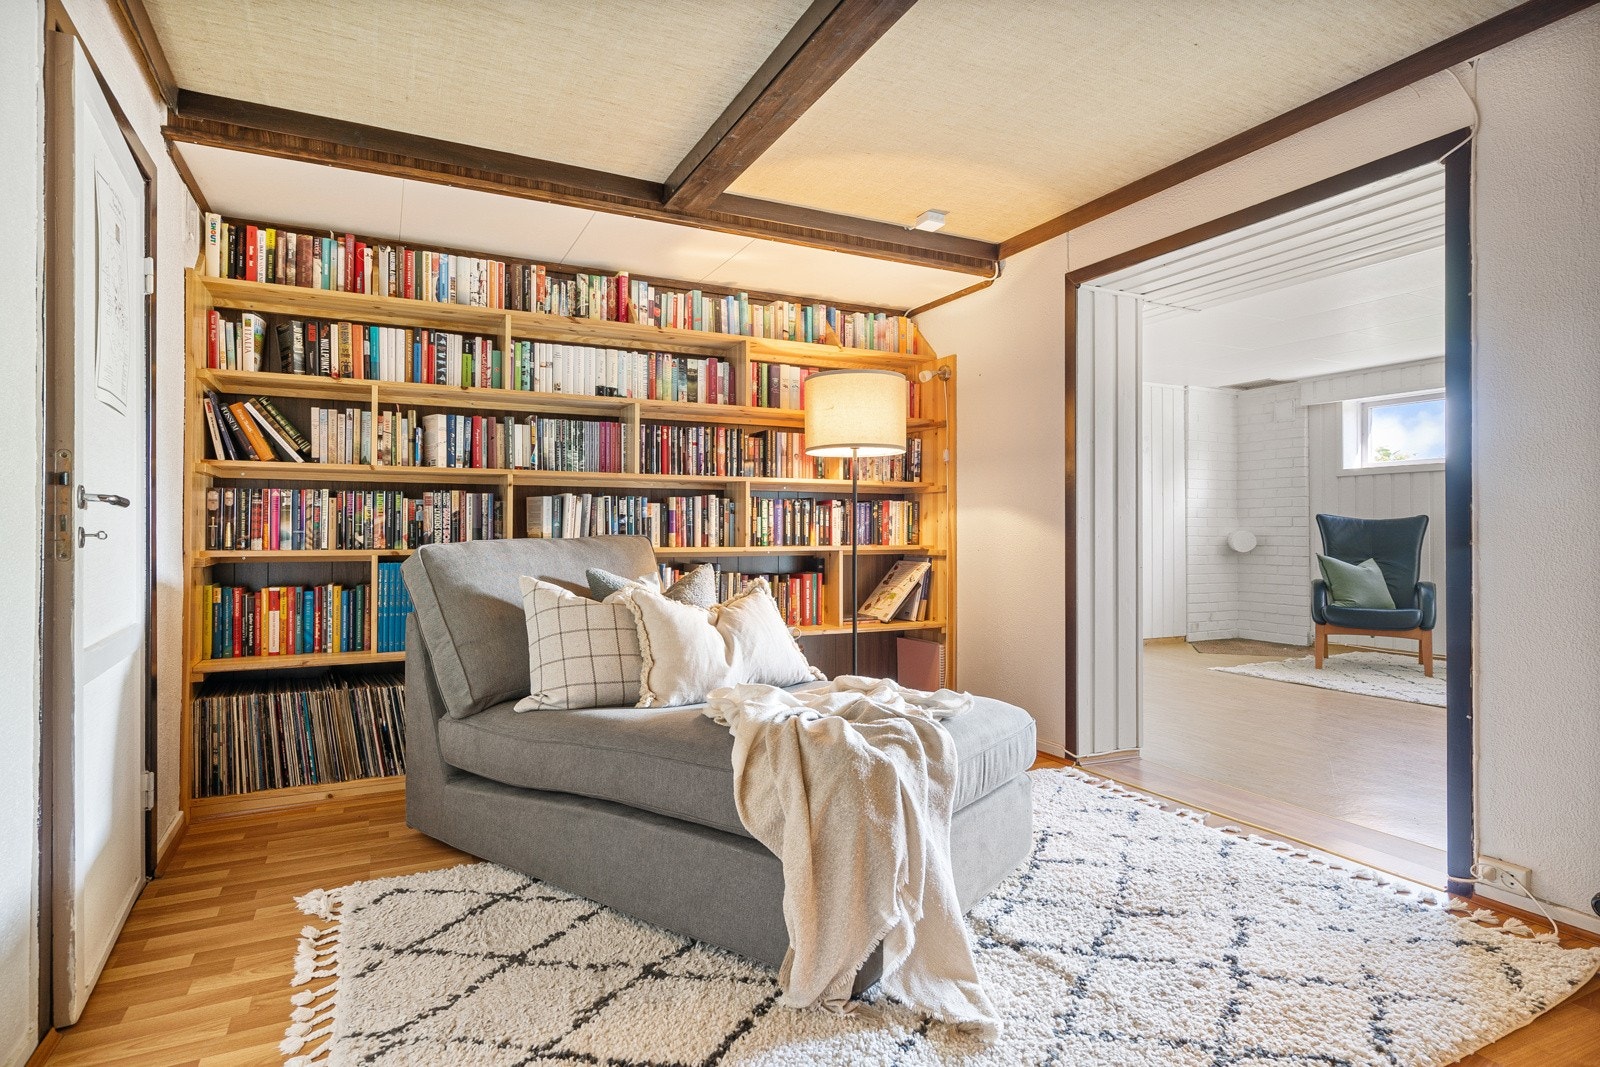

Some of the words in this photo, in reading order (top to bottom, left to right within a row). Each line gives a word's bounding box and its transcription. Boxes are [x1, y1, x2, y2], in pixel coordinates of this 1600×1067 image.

[244, 328, 252, 354] ITALIA
[320, 338, 330, 374] NULLPUNKT
[221, 406, 240, 432] FOSSUM
